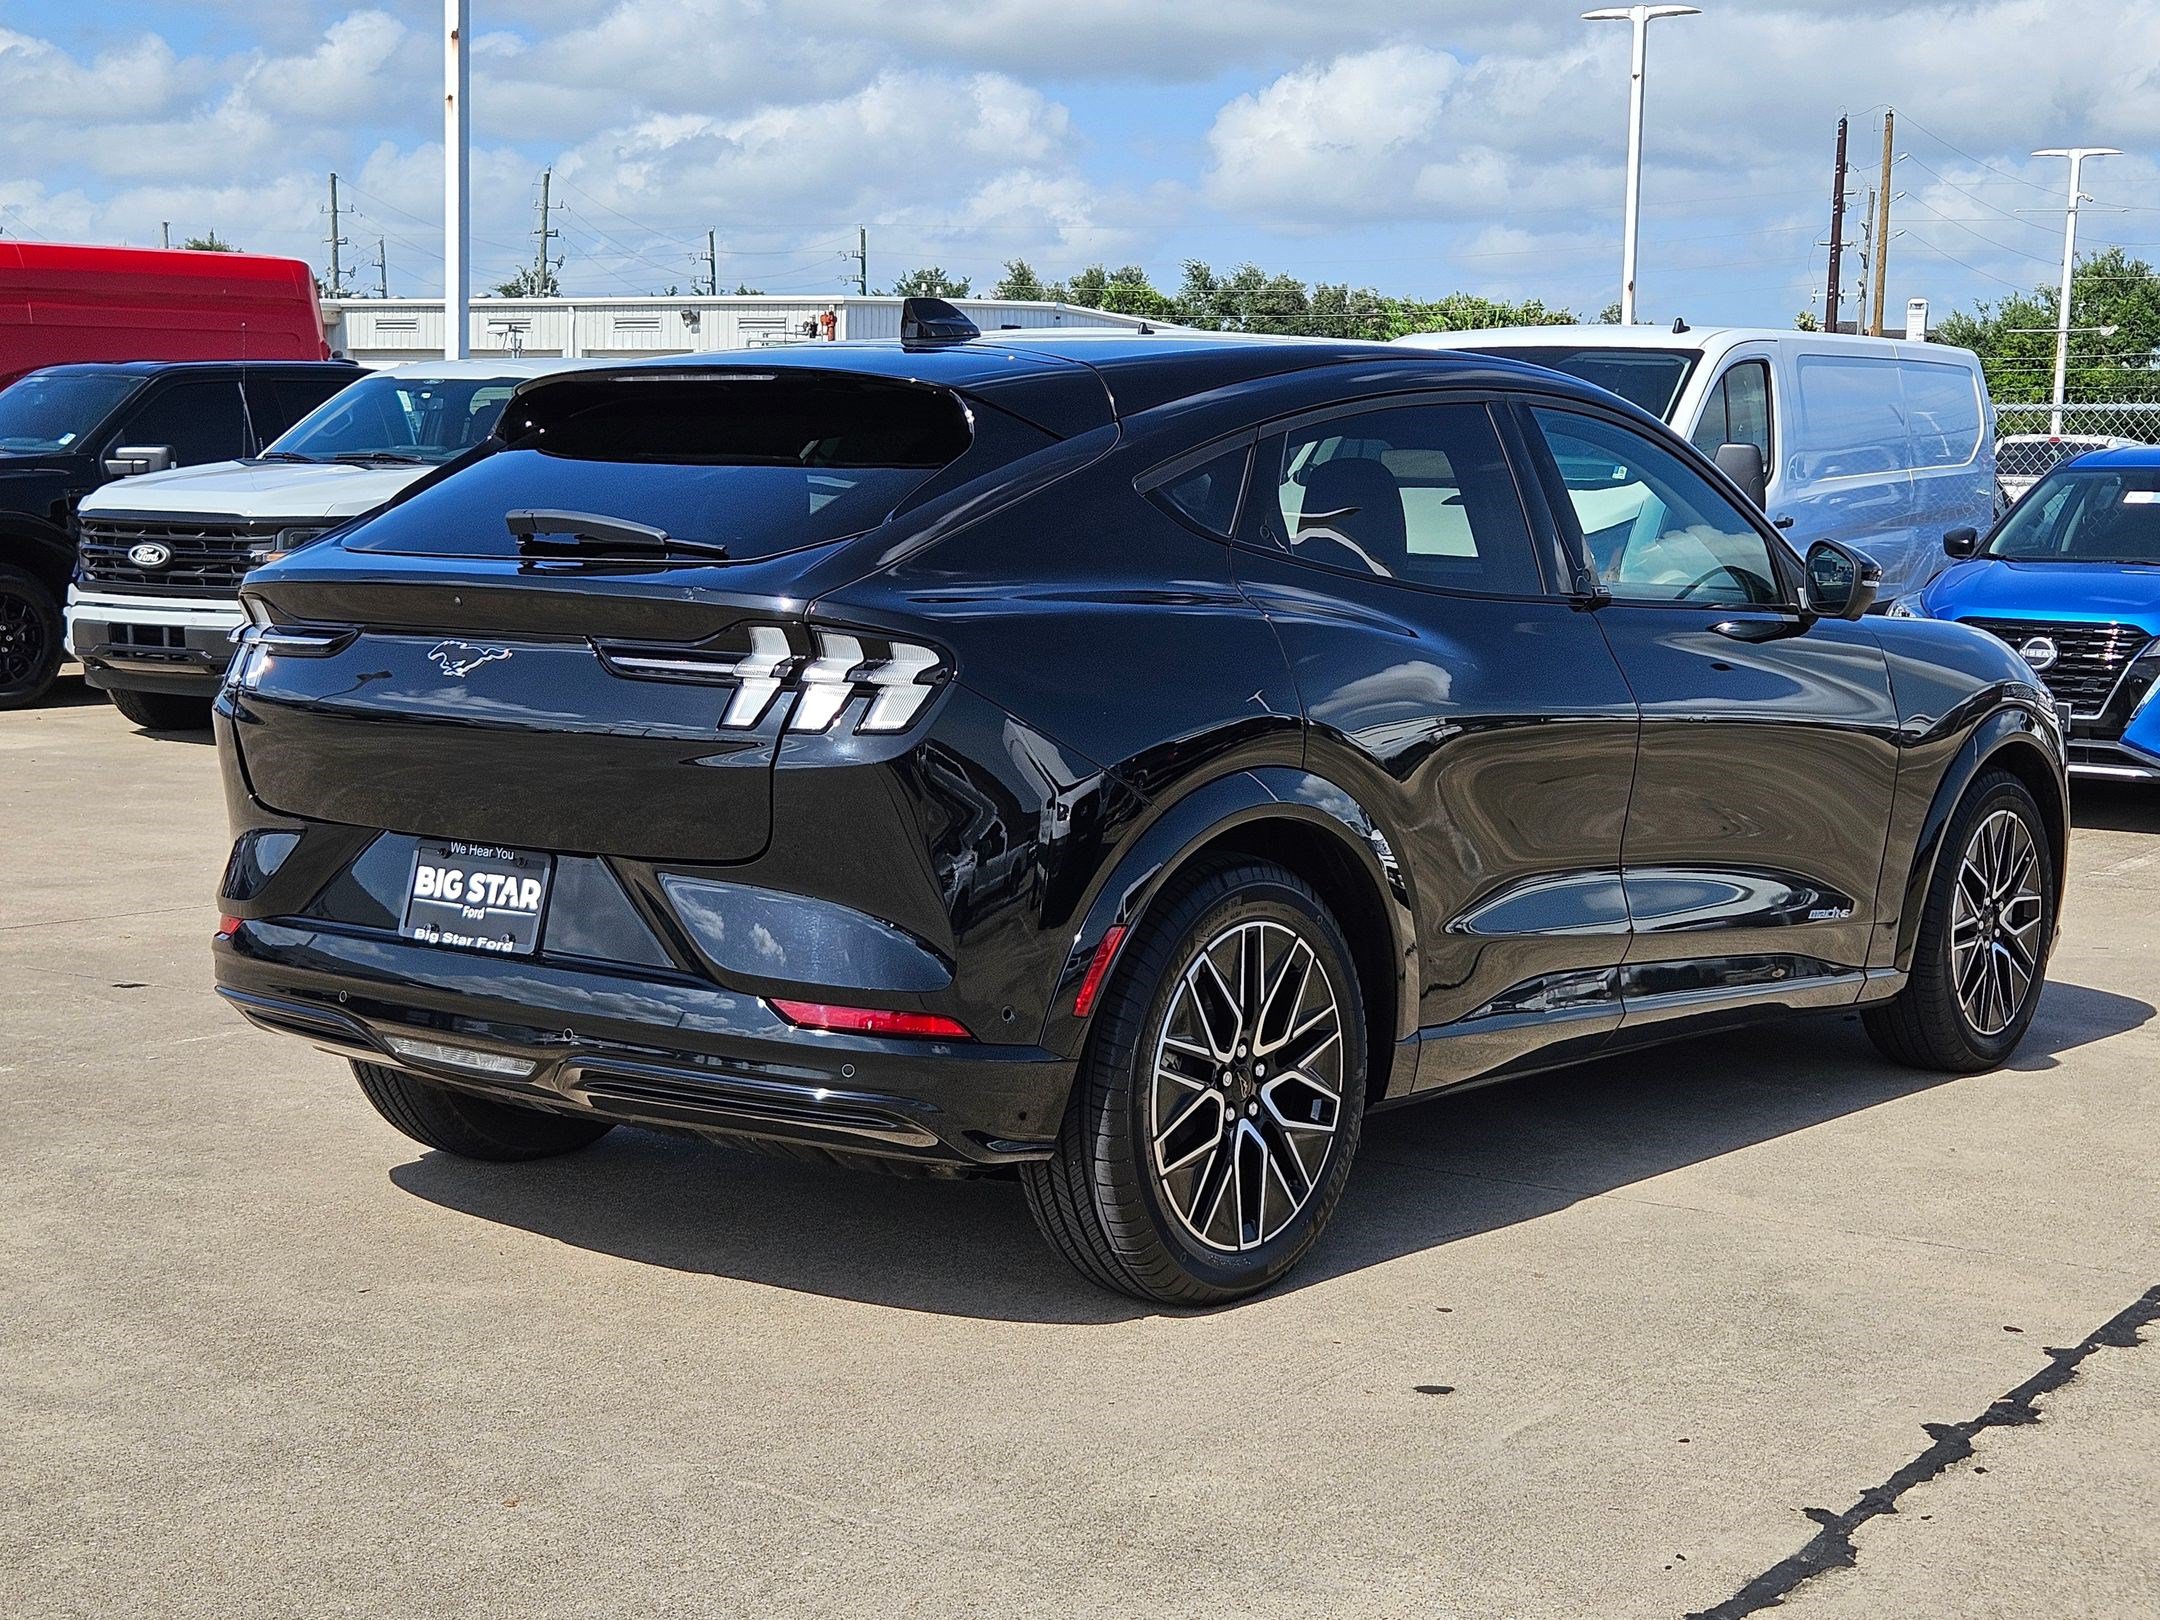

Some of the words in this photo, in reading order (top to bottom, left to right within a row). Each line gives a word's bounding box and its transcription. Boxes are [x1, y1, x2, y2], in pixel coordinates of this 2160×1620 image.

[135, 547, 159, 562] Ford
[2020, 648, 2057, 658] NISSAN
[450, 842, 466, 854] We
[469, 844, 493, 857] Hear
[495, 847, 514, 860] You
[414, 865, 463, 900] BIG
[466, 872, 542, 910] STAR
[462, 906, 485, 920] Ford
[414, 928, 439, 943] Big
[442, 932, 475, 947] Star
[477, 937, 514, 952] Ford
